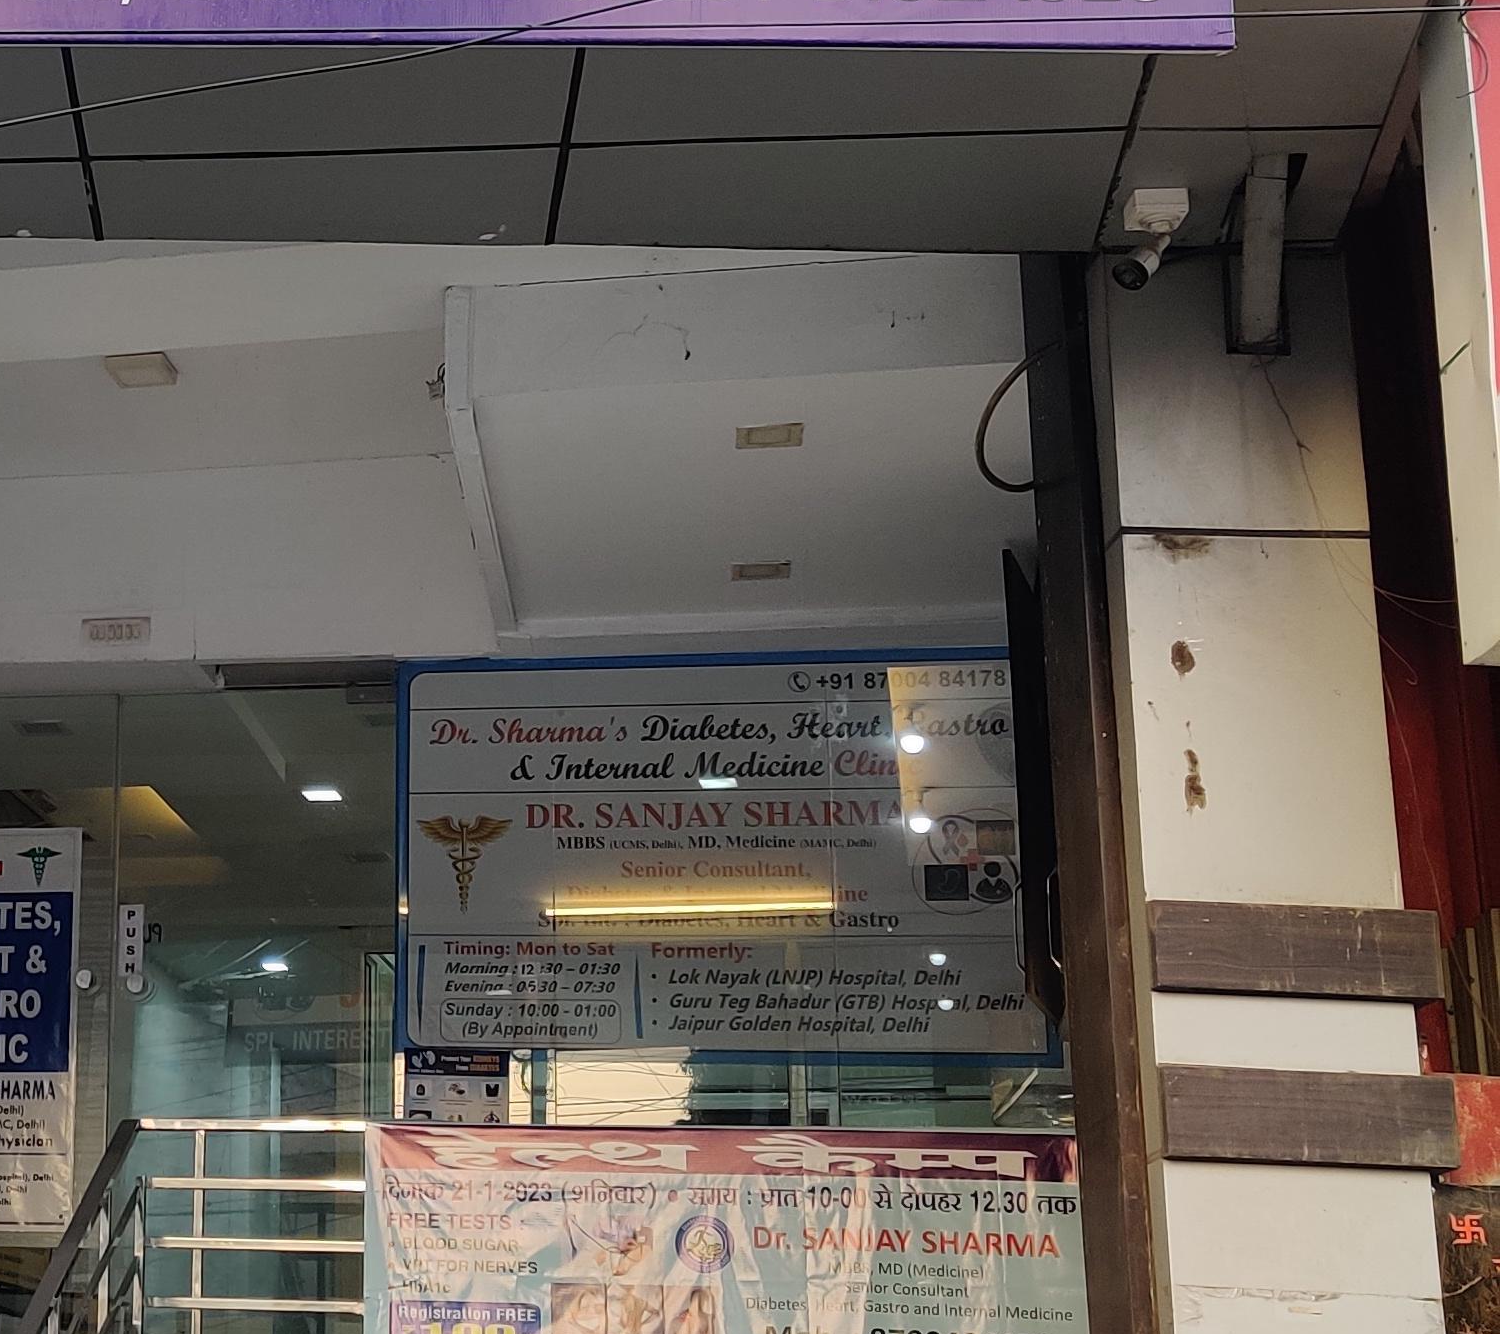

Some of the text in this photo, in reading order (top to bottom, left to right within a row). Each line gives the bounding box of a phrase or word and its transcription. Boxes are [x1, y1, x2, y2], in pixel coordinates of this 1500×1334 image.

[429, 714, 776, 745] Dr. Sharma's Diabetes,
[26, 944, 47, 974] &
[651, 942, 752, 963] Formerly:
[668, 969, 962, 990] Lok Nayak (LNJP) Hospital, Delhi
[753, 1226, 1061, 1258] Dr. SANJAY SHARMA
